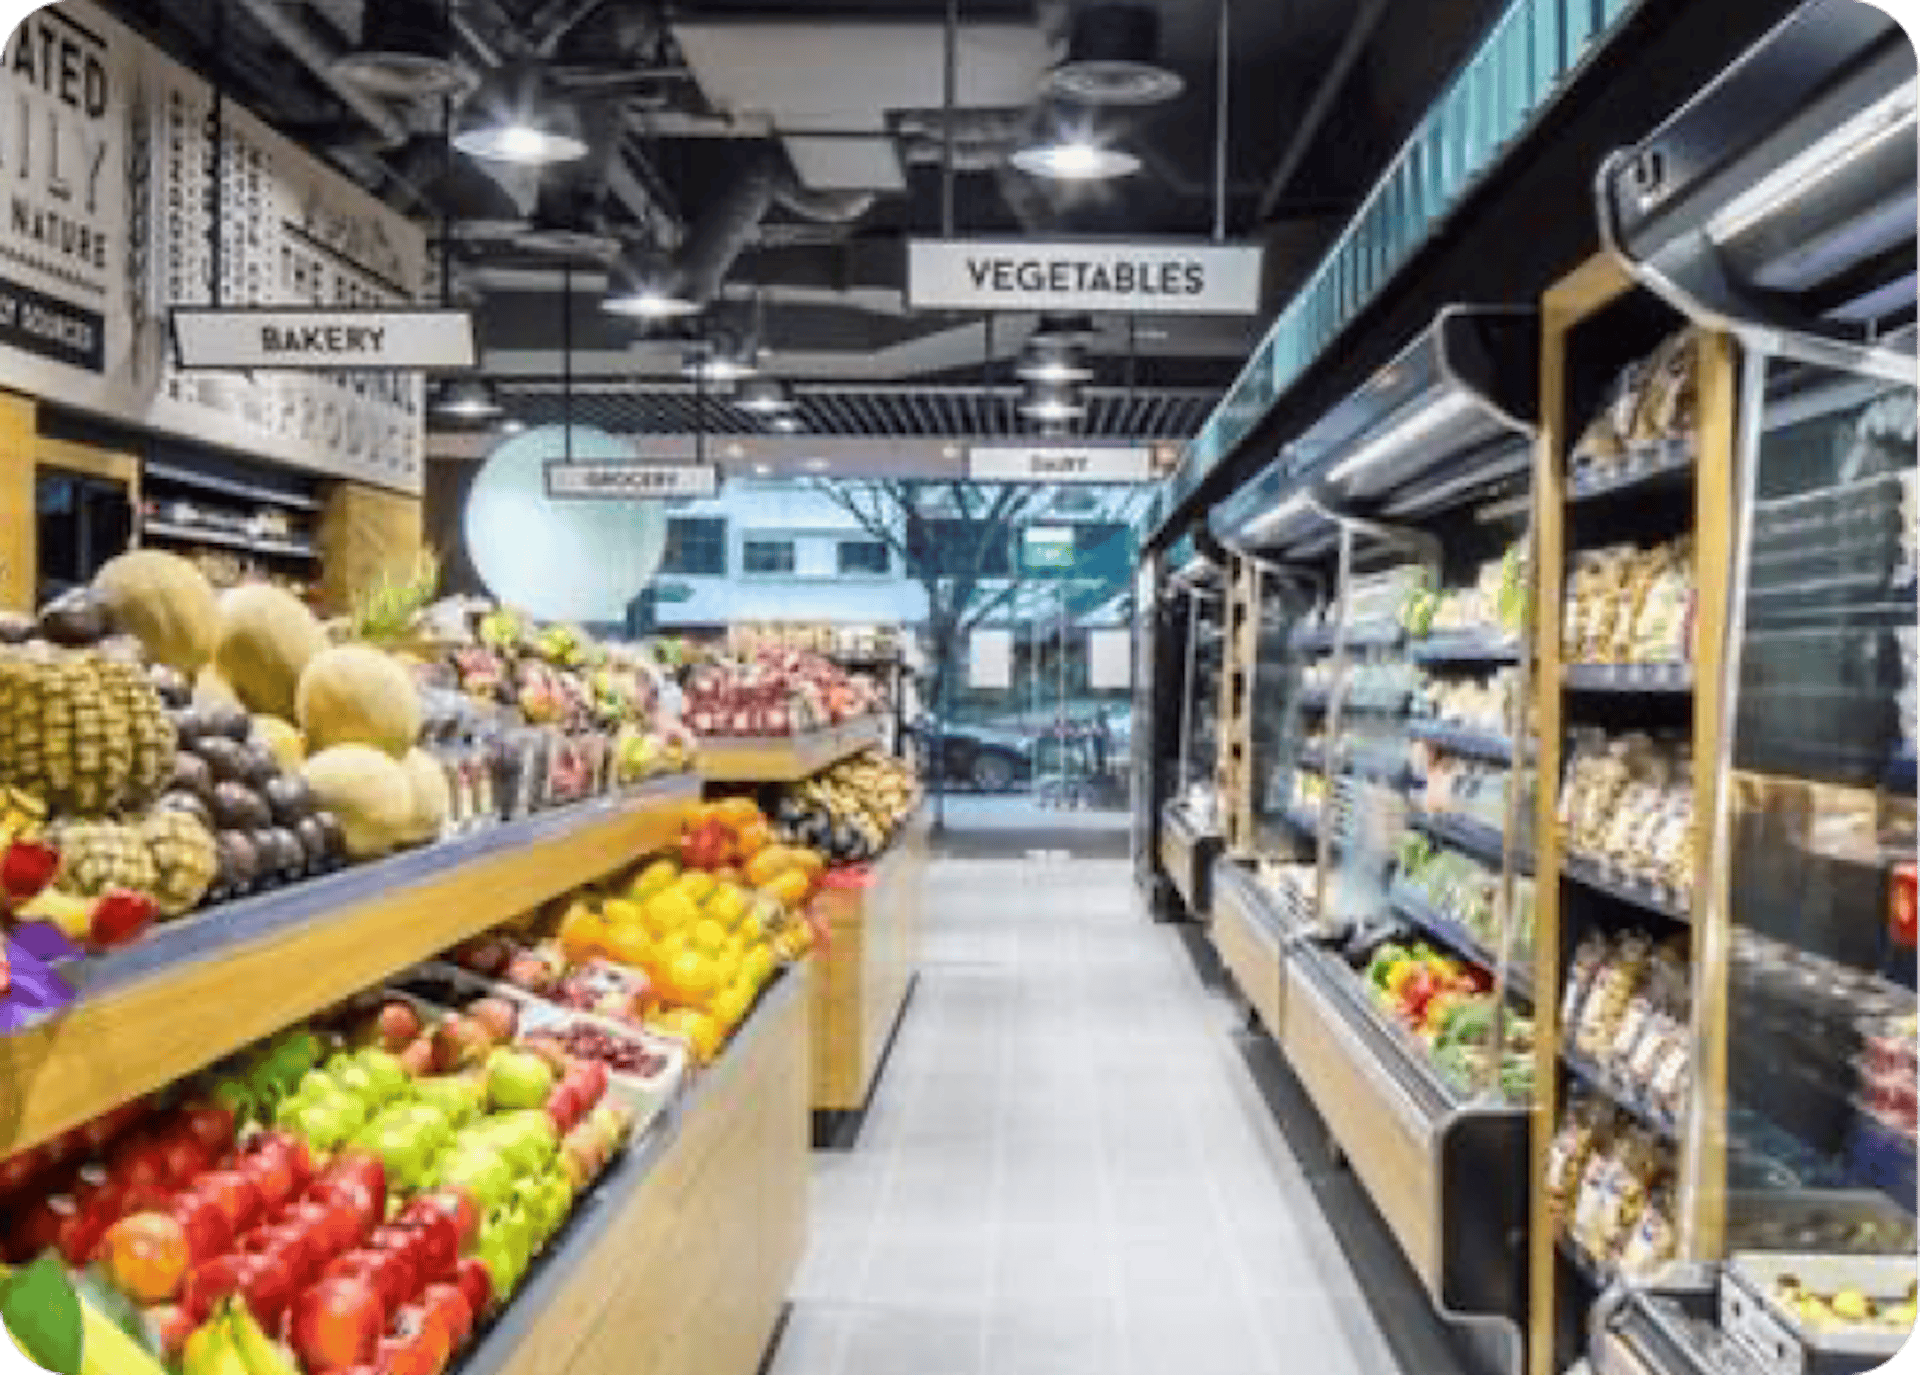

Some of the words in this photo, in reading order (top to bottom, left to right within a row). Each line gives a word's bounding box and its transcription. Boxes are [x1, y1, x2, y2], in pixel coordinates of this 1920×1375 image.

[11, 193, 105, 269] NATURE
[967, 257, 1205, 294] VEGETABLES
[262, 326, 385, 353] BAKERY
[586, 472, 679, 487] GROCERY
